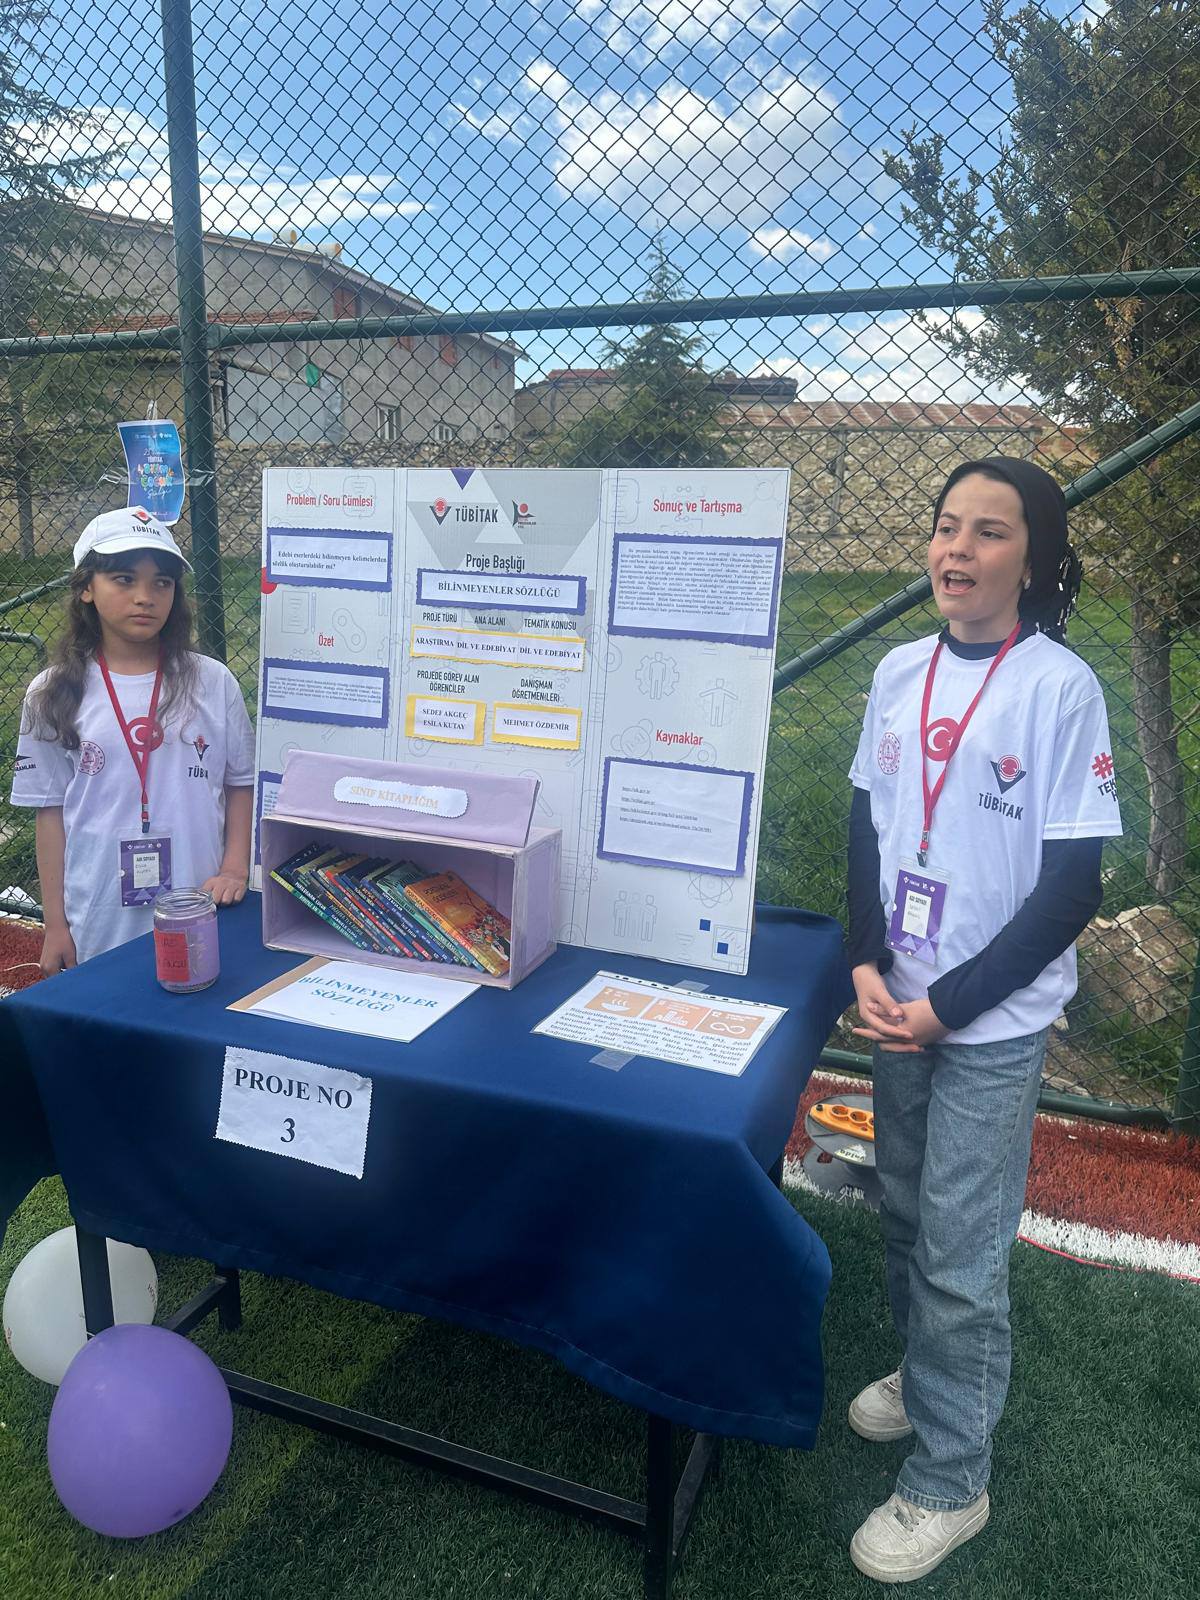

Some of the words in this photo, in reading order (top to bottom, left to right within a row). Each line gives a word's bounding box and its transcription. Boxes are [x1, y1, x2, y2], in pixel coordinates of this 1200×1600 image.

[286, 494, 316, 506] Problem
[323, 494, 340, 506] Soru
[342, 494, 373, 507] Cümlesi
[654, 499, 683, 516] Sonuç
[686, 502, 697, 512] ve
[700, 500, 742, 516] Tartışma
[456, 505, 498, 523] TÜBİTAK
[466, 554, 490, 572] Proje
[493, 554, 525, 573] Başlığı
[438, 582, 514, 595] BİLİNMEYENLER
[515, 585, 561, 598] SÖZLÜĞÜ
[423, 612, 440, 622] PROJE
[442, 612, 458, 622] TÜRÜ
[474, 616, 486, 624] ANA
[488, 616, 505, 626] ALANI
[524, 618, 550, 629] TEMATİK
[551, 620, 577, 630] KONUSU
[318, 633, 334, 648] Özet
[416, 637, 454, 647] ARAŞTIRMA
[457, 641, 470, 649] DİL
[482, 644, 516, 653] EDEBİYAT
[520, 646, 532, 654] DİL
[544, 650, 581, 659] EDEBİYAT
[417, 670, 442, 680] PROJEDE
[464, 674, 480, 683] ALAN
[520, 679, 553, 690] DANIŞMAN
[656, 729, 704, 746] Kaynaklar
[978, 792, 1024, 821] TÜBİTAK
[299, 976, 438, 1008] BİLİNMEYENLER
[311, 988, 395, 1012] SÖZLÜĞÜ
[234, 1067, 310, 1102] PROJE
[318, 1084, 353, 1109] NO
[280, 1117, 296, 1142] 3
